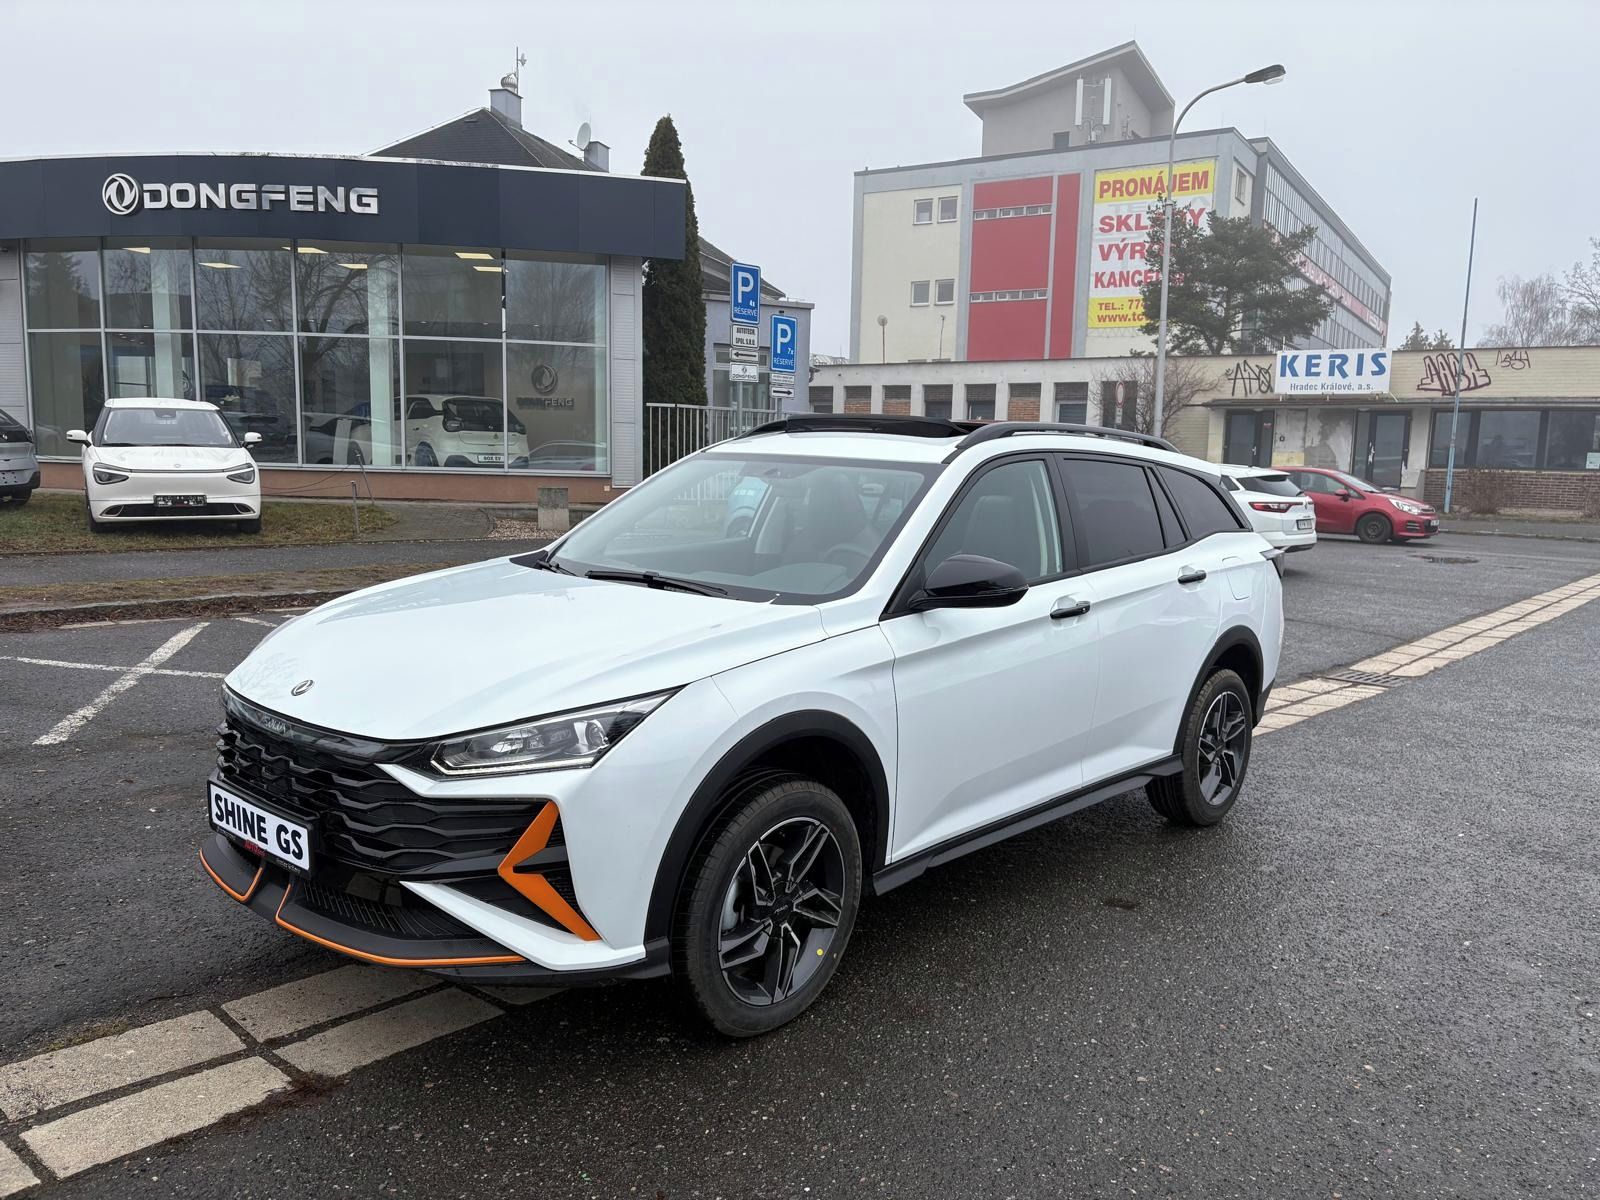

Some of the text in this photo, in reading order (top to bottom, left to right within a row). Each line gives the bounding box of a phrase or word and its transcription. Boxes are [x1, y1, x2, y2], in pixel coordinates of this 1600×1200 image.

[1099, 170, 1209, 198] PRONÁJEM
[143, 183, 378, 214] DONGFENG
[1099, 208, 1206, 234] SKLY
[737, 271, 754, 304] P
[1097, 311, 1147, 322] www.tc
[1128, 299, 1145, 310] 77
[777, 323, 791, 354] P
[1279, 352, 1388, 379] KERIS
[1290, 383, 1318, 391] Hradec
[1320, 381, 1355, 391] Králové,
[517, 398, 574, 409] FENG
[214, 793, 303, 860] SHINE GS
